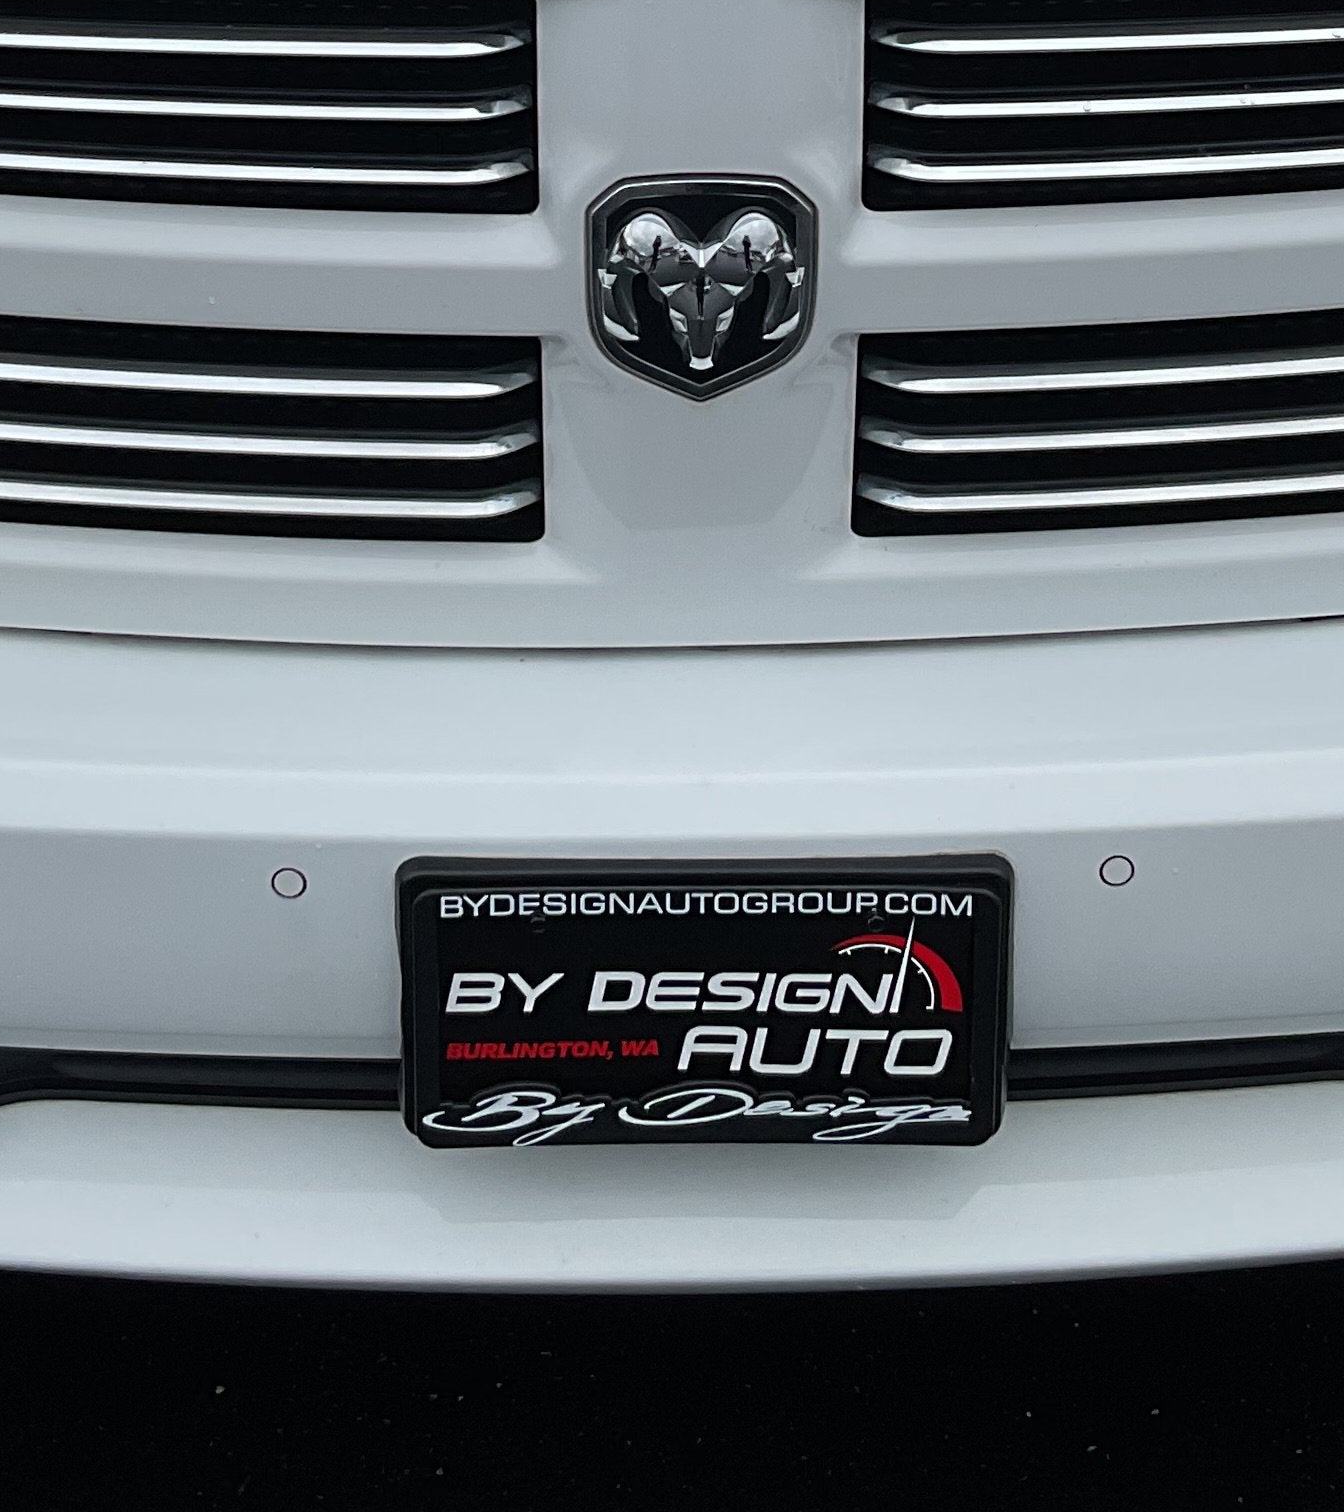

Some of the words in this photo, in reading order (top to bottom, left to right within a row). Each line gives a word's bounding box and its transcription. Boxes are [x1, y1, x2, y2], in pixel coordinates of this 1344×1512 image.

[440, 891, 973, 918] BYDESIGNAUTOGROUP.COM
[445, 972, 565, 1014] BY
[587, 971, 895, 1015] DESIGN
[446, 1040, 614, 1061] BURLINGTON,
[621, 1038, 660, 1058] WA
[677, 1025, 954, 1077] AUTO
[422, 1090, 606, 1147] By
[618, 1088, 973, 1141] Design
